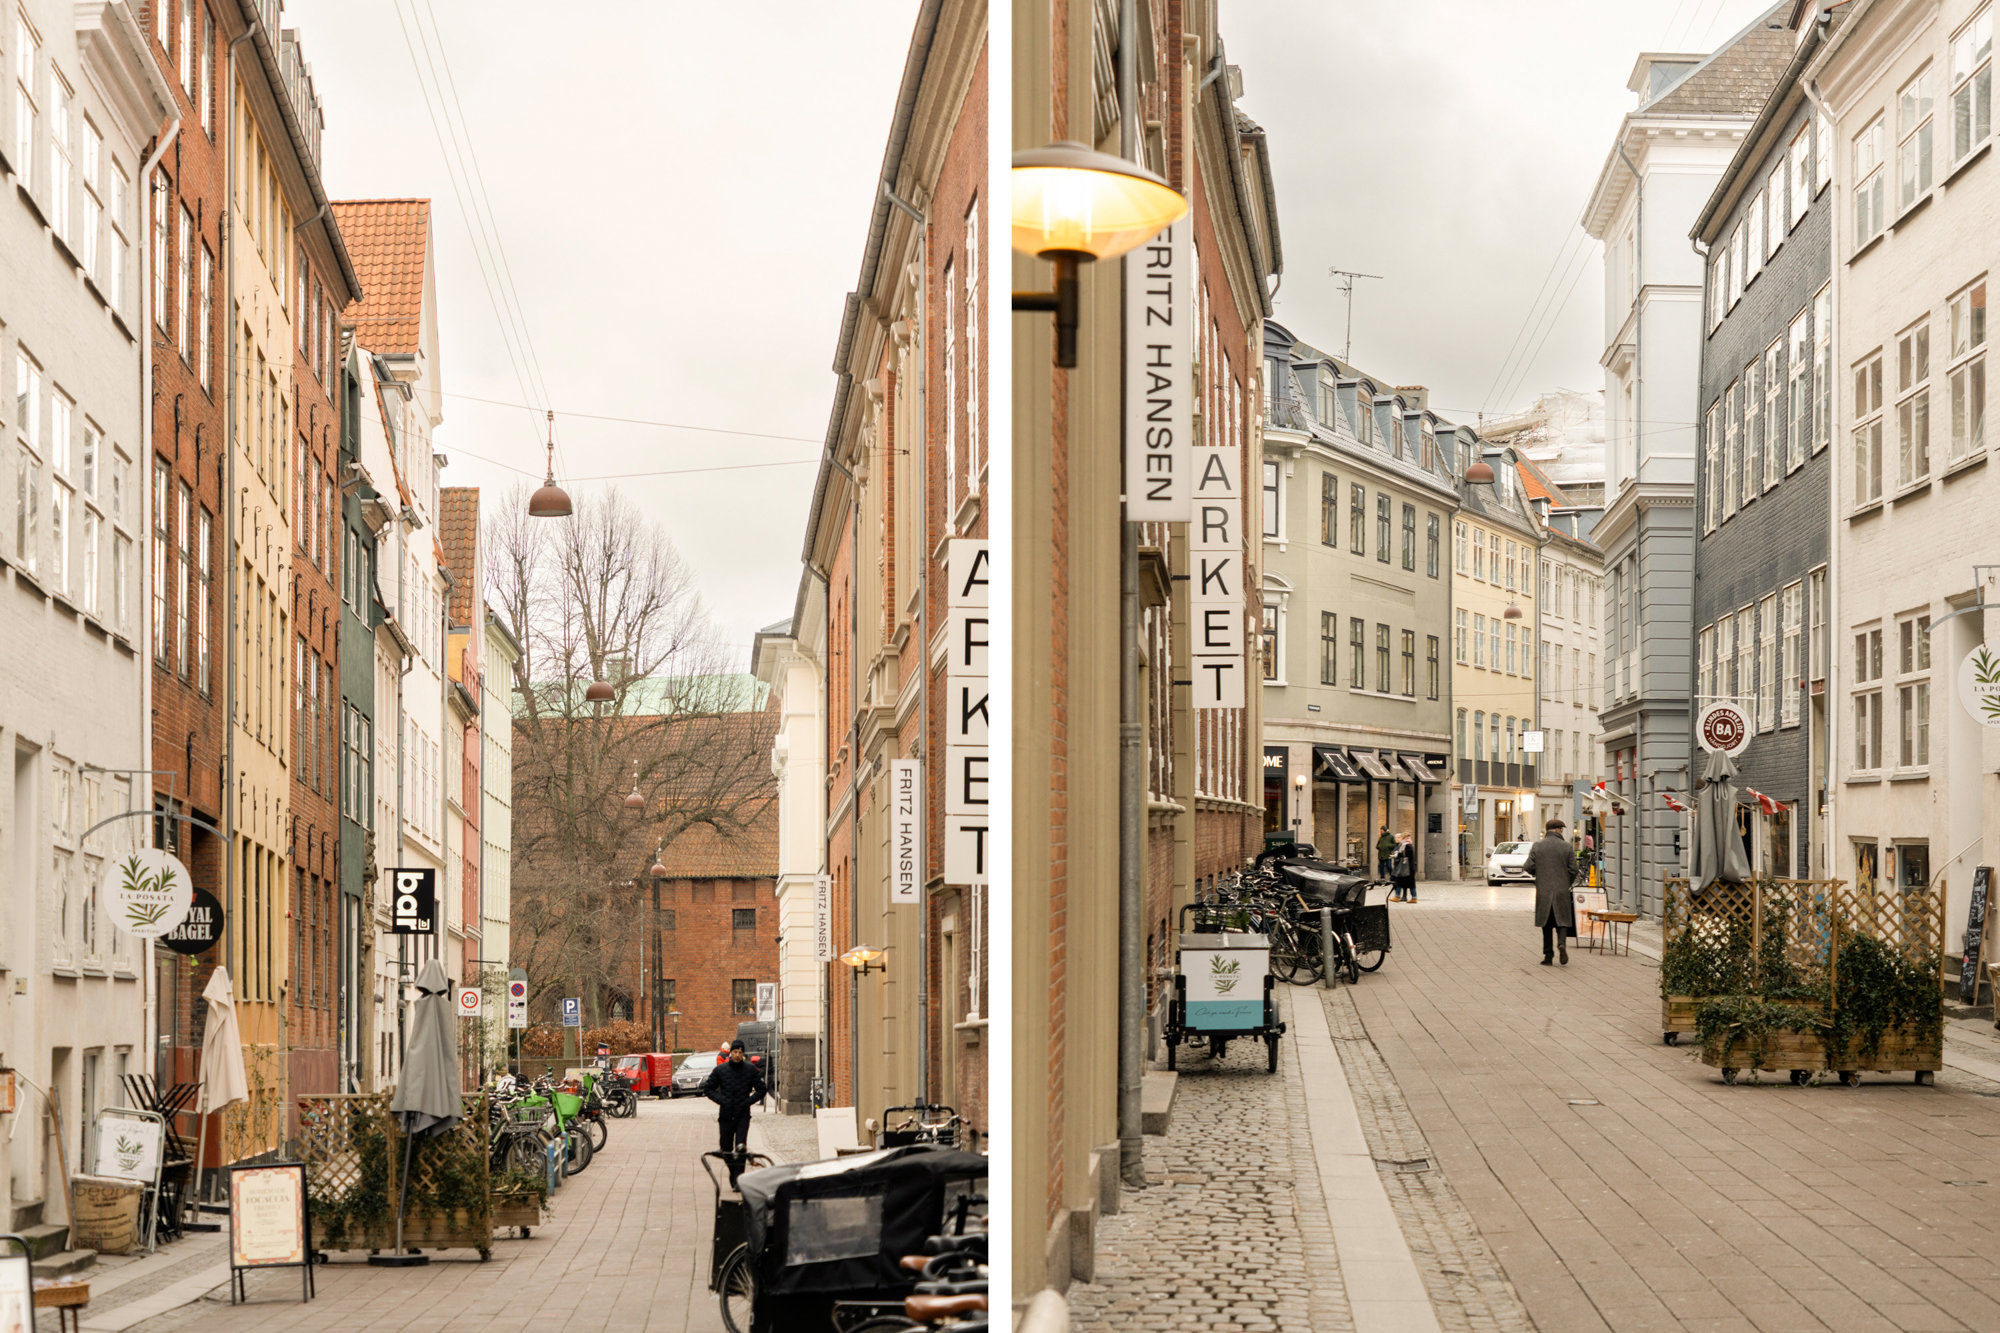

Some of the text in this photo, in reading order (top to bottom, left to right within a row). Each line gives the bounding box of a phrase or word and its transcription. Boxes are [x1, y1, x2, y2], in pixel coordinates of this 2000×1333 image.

[1146, 344, 1173, 501] HANSEN
[1198, 453, 1233, 701] ARKET
[1704, 709, 1724, 731] BLINDES
[1715, 722, 1733, 736] BA
[1724, 710, 1744, 733] ARBEJDE
[900, 768, 912, 895] FRITZ HANSEN
[136, 893, 175, 902] POSATA
[396, 872, 424, 931] bar
[818, 880, 827, 957] FRITZ HANSEN
[168, 922, 213, 940] BAGEL
[464, 996, 476, 1004] 30
[566, 1000, 575, 1014] P
